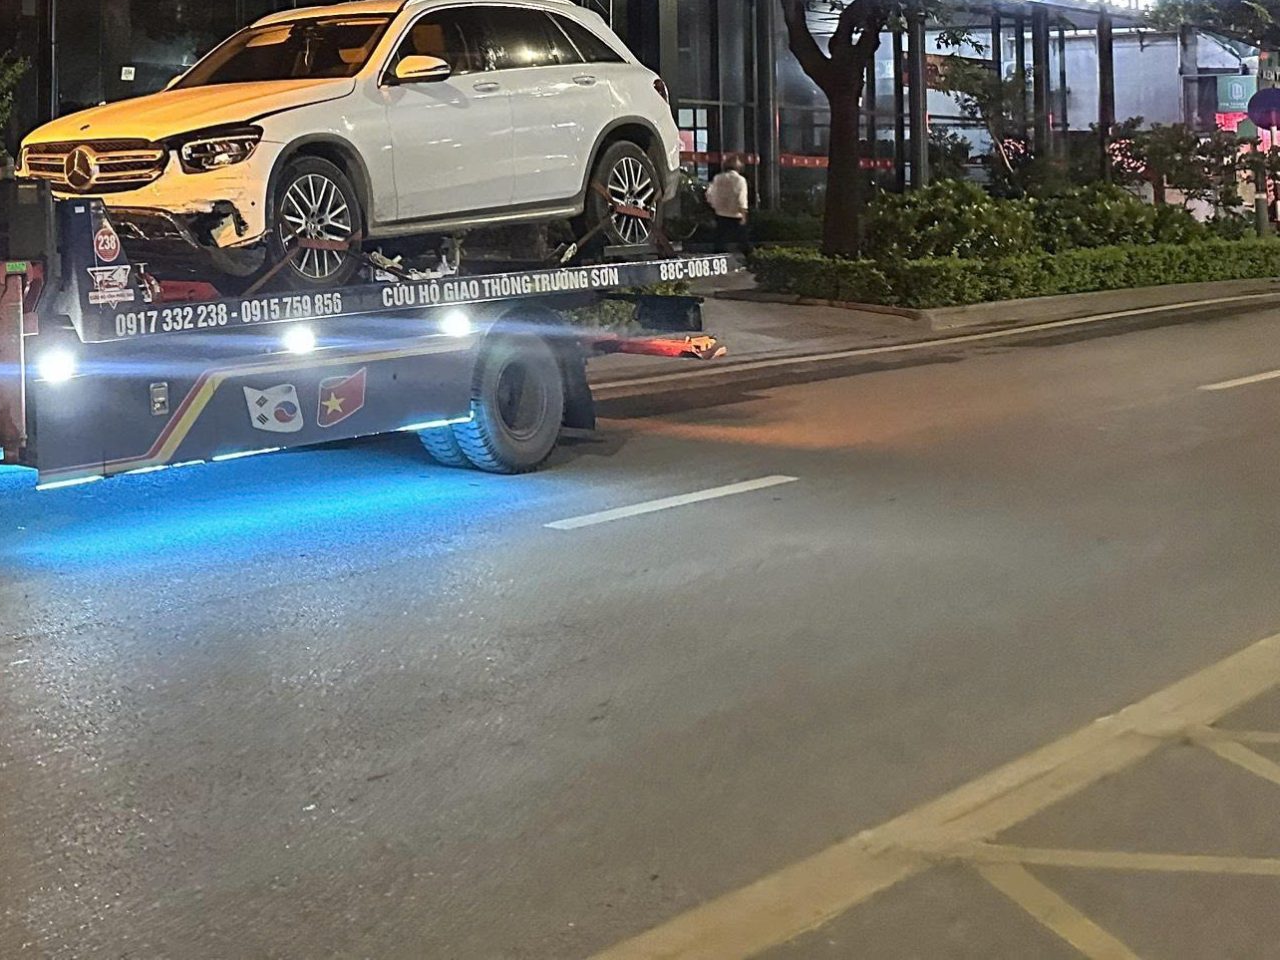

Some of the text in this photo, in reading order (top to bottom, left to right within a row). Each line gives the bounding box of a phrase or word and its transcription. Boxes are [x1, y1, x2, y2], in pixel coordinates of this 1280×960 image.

[97, 235, 116, 250] 238
[660, 258, 728, 281] 88C-008.98
[382, 281, 415, 307] CỨU
[419, 278, 440, 305] HỘ
[443, 280, 479, 302] GIAO
[482, 273, 532, 297] THÔNG
[591, 267, 620, 287] SƠN
[115, 310, 158, 336] 0917
[162, 307, 194, 332] 332
[197, 303, 228, 328] 238
[241, 298, 279, 323] 0915
[282, 295, 312, 317] 759
